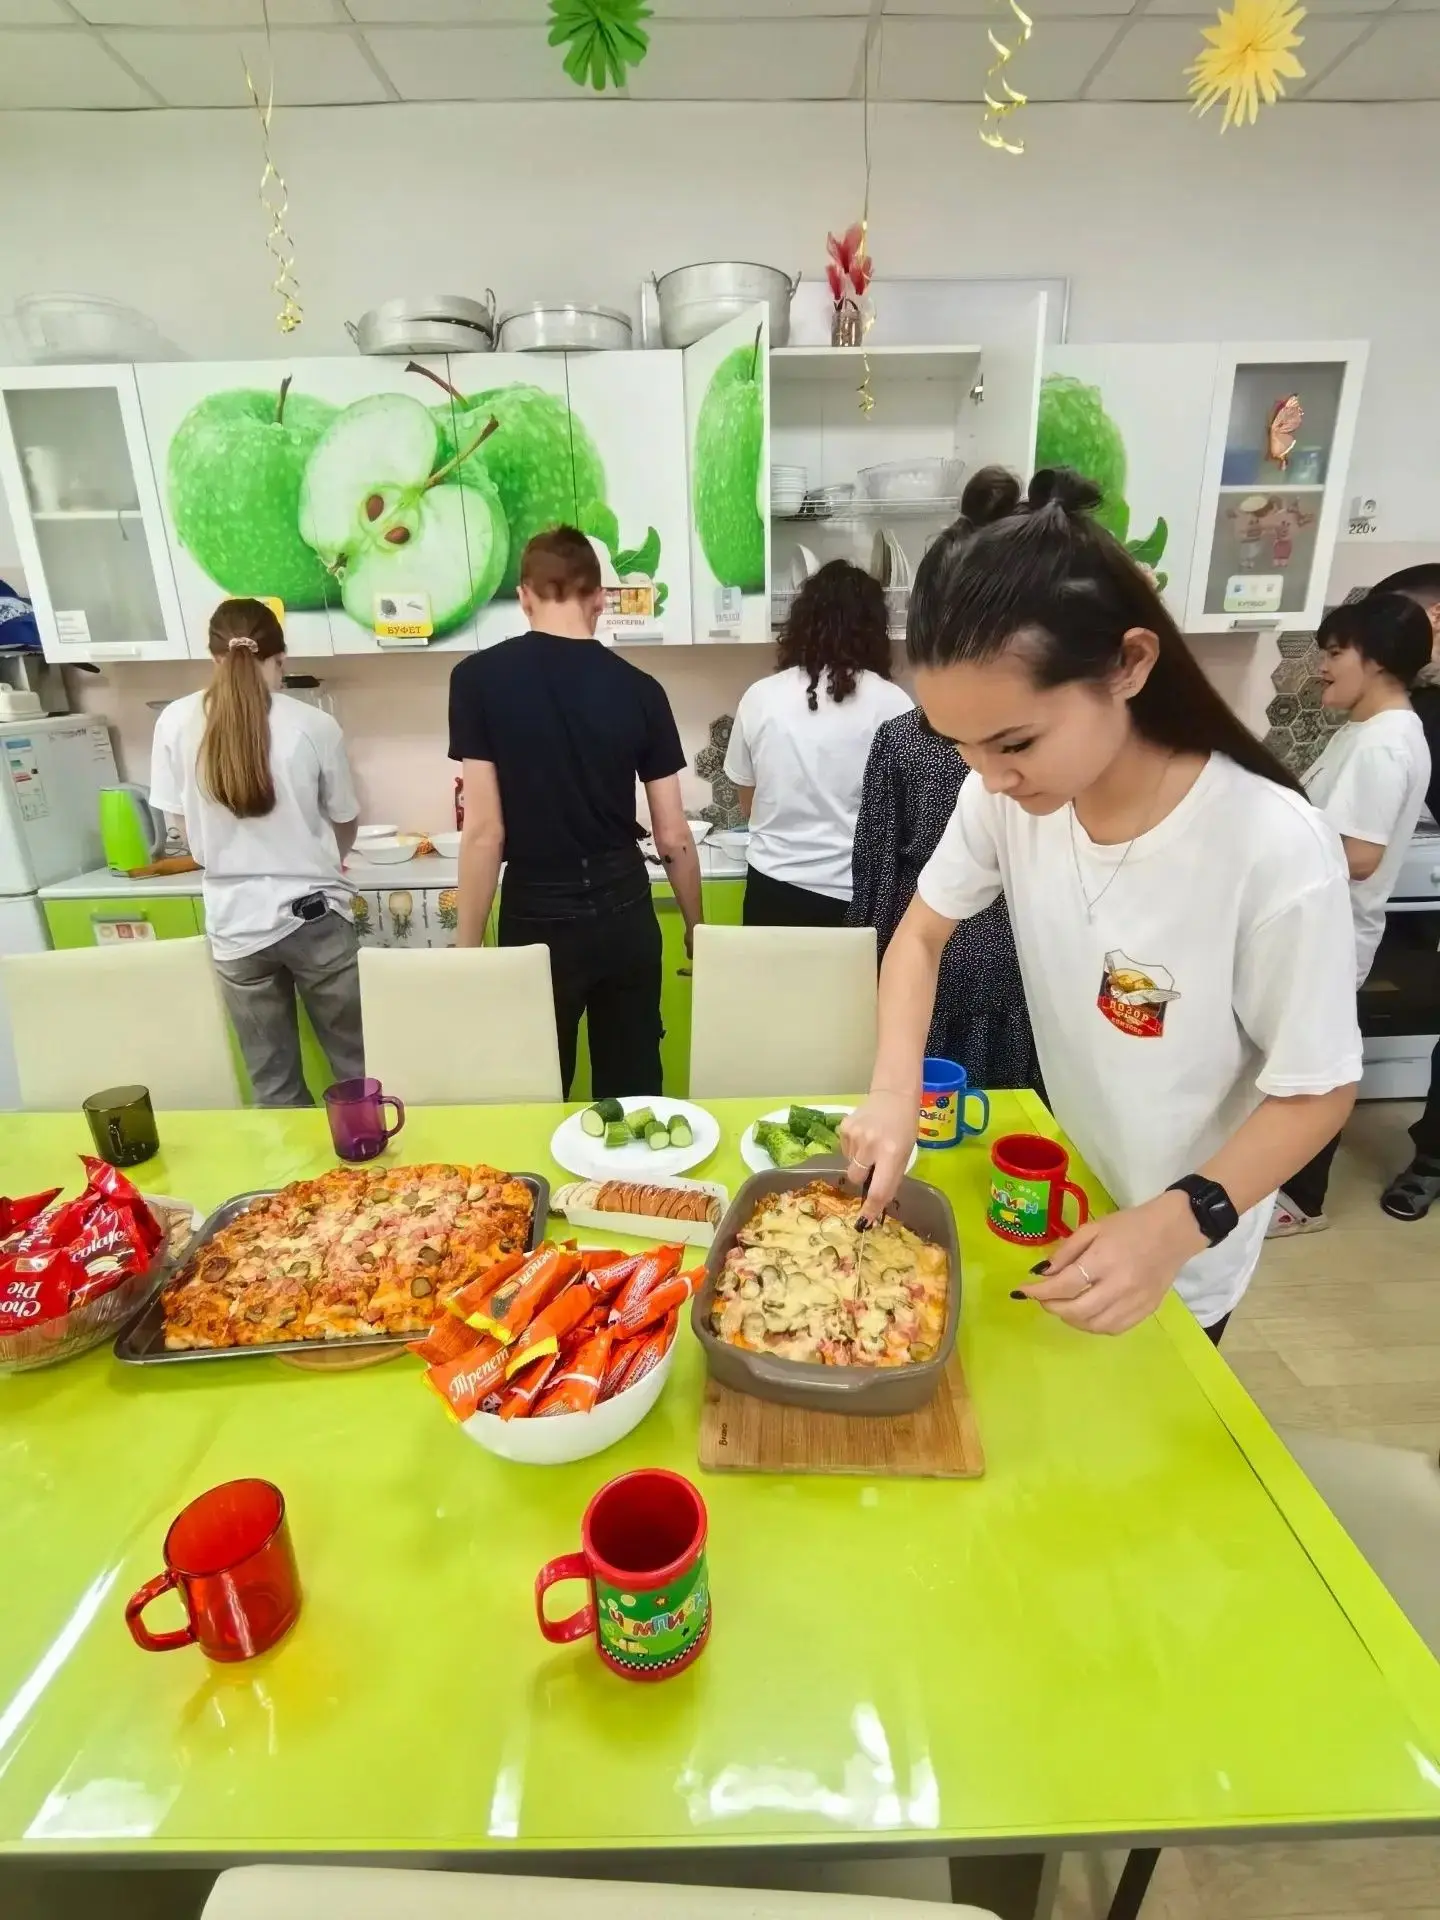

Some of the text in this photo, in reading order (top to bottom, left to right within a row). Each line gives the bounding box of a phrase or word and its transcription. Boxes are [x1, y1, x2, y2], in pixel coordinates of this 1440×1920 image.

[387, 625, 422, 635] БУФЕТ
[7, 1281, 43, 1299] Pie
[0, 1299, 41, 1317] Cho
